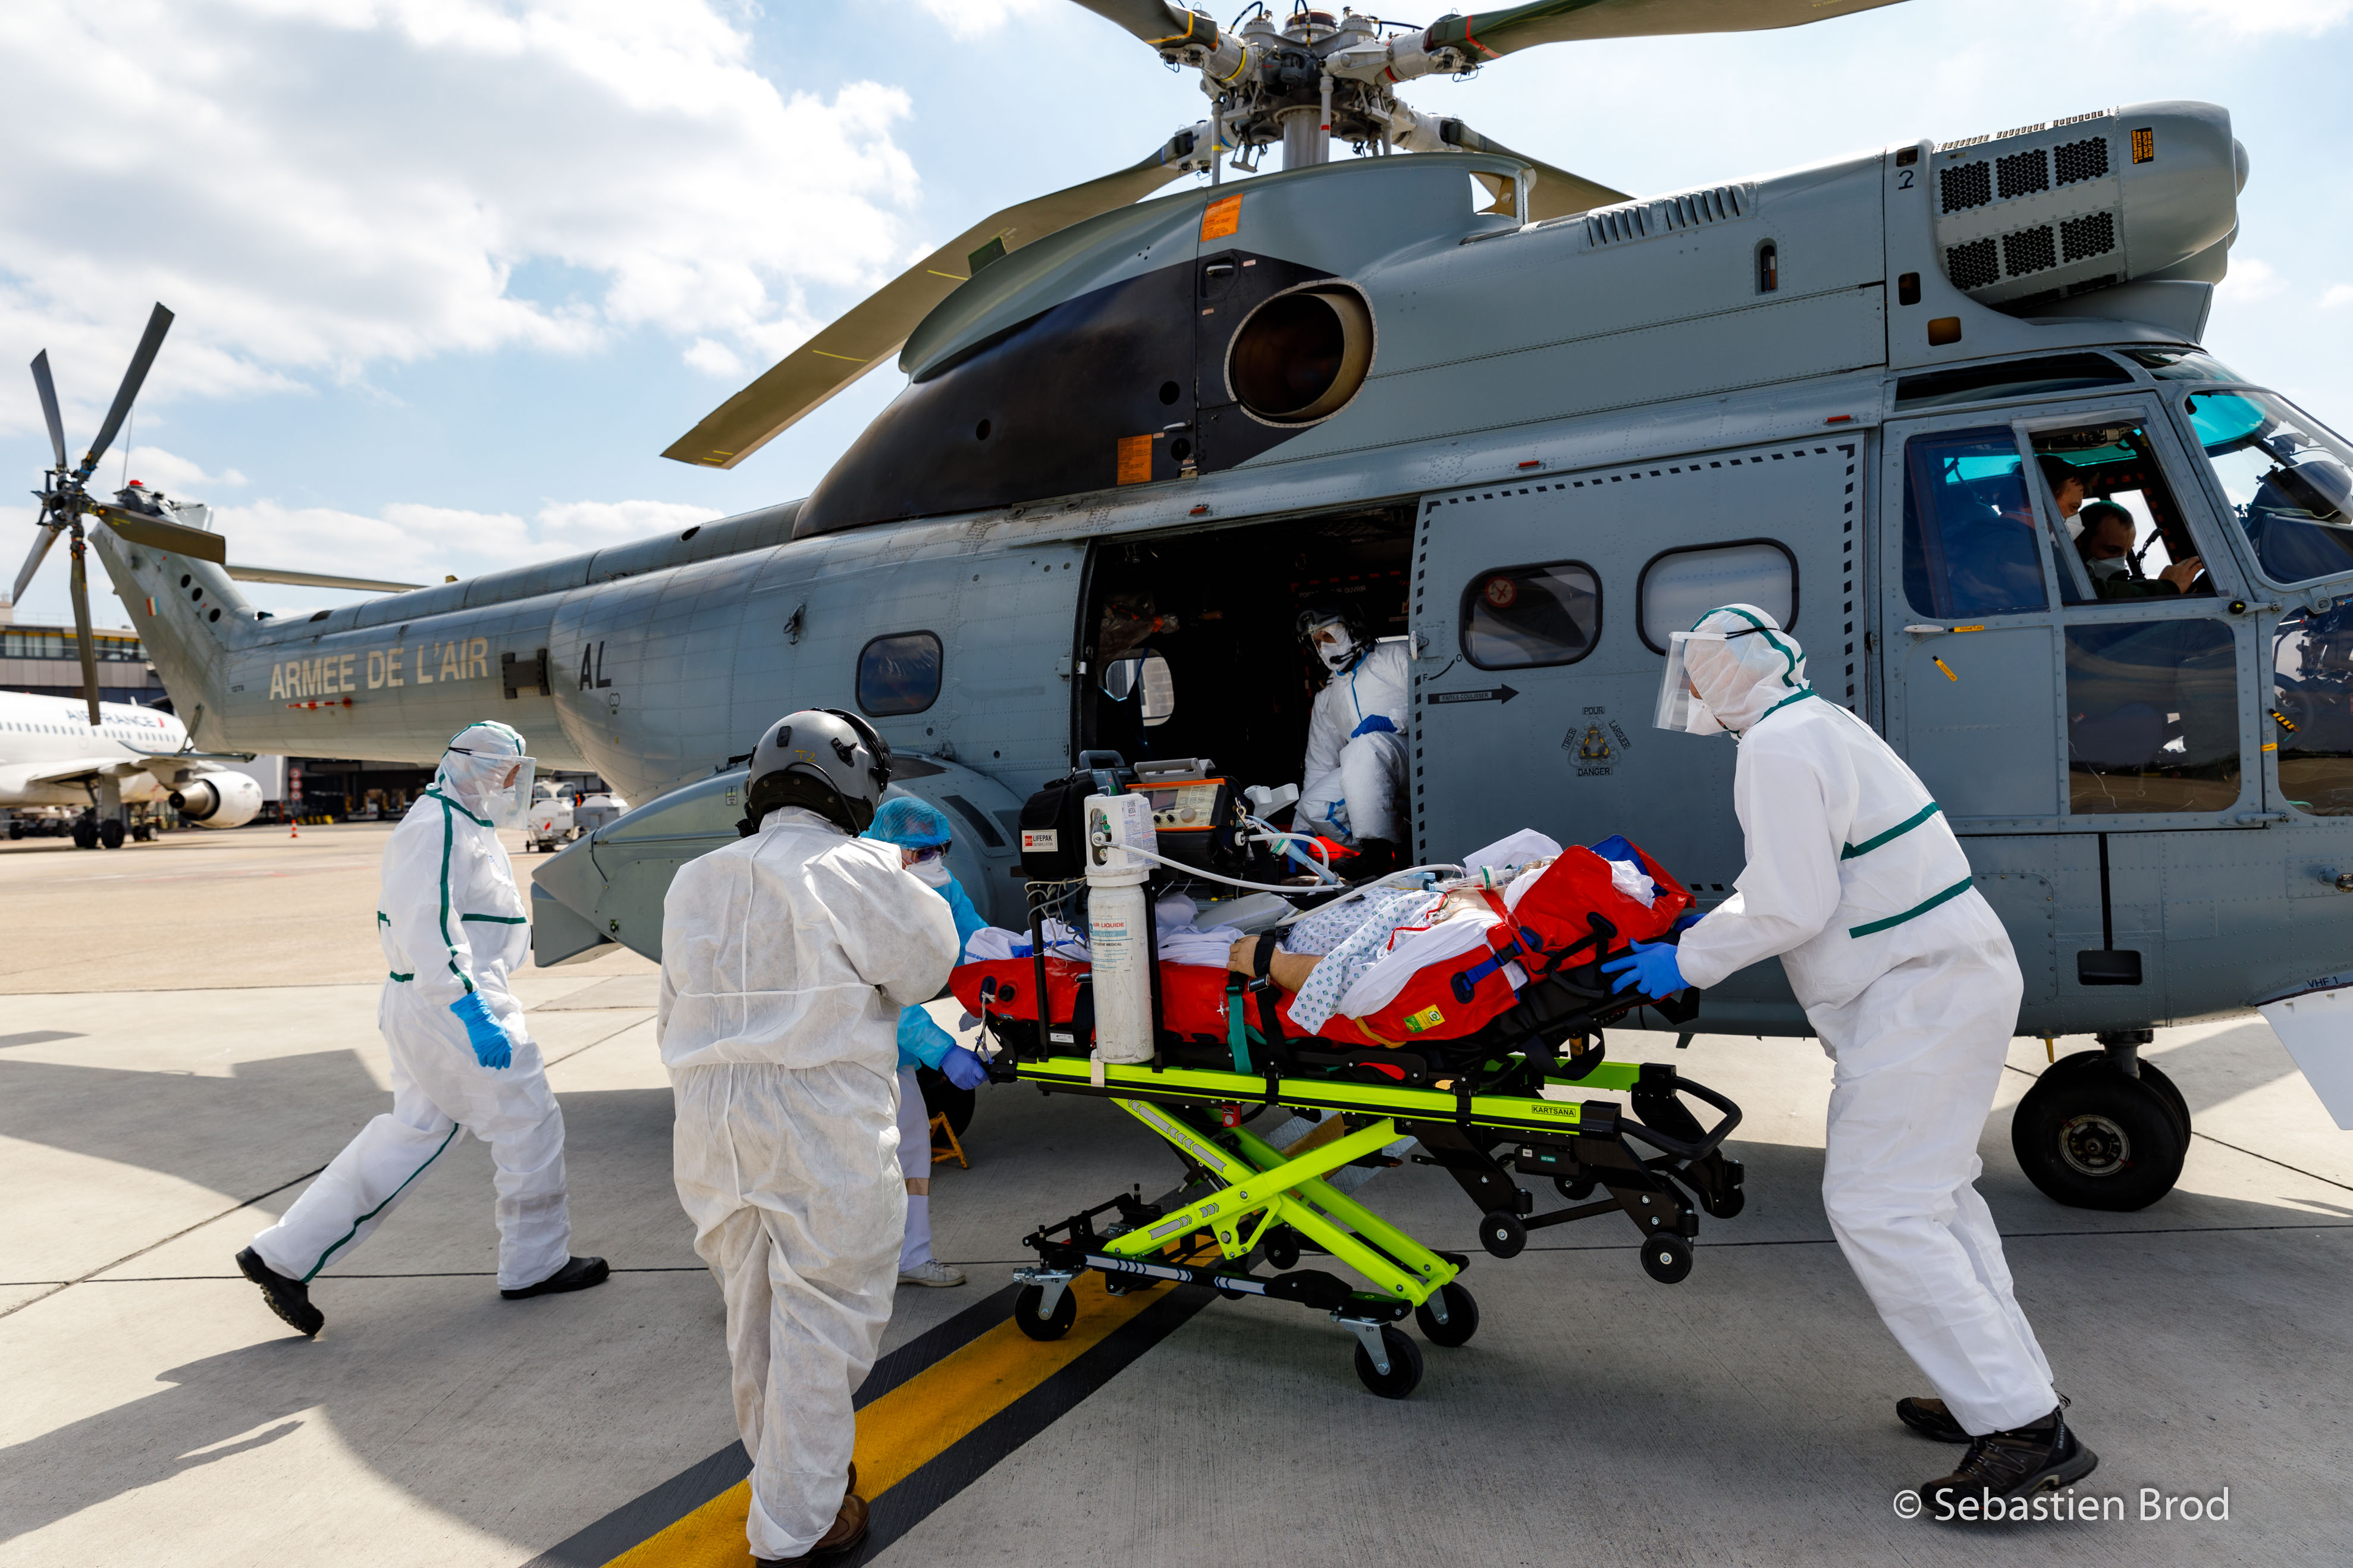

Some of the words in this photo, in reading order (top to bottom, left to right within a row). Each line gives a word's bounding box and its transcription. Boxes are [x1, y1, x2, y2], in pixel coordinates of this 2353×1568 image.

[1899, 170, 1913, 190] 2
[269, 653, 355, 700] ARMEE
[368, 648, 405, 690] DE
[418, 637, 489, 684] L'AIR
[579, 641, 611, 691] AL
[1940, 664, 1956, 681] OUVERTURE
[1423, 674, 1428, 682] F
[1584, 706, 1604, 715] POUR
[1562, 728, 1577, 750] TIRER
[1609, 719, 1630, 749] LARGUER
[1577, 768, 1610, 776] DANGER
[2307, 977, 2329, 988] VHF
[2333, 976, 2338, 985] 1
[1533, 1107, 1574, 1115] KARTSANA
